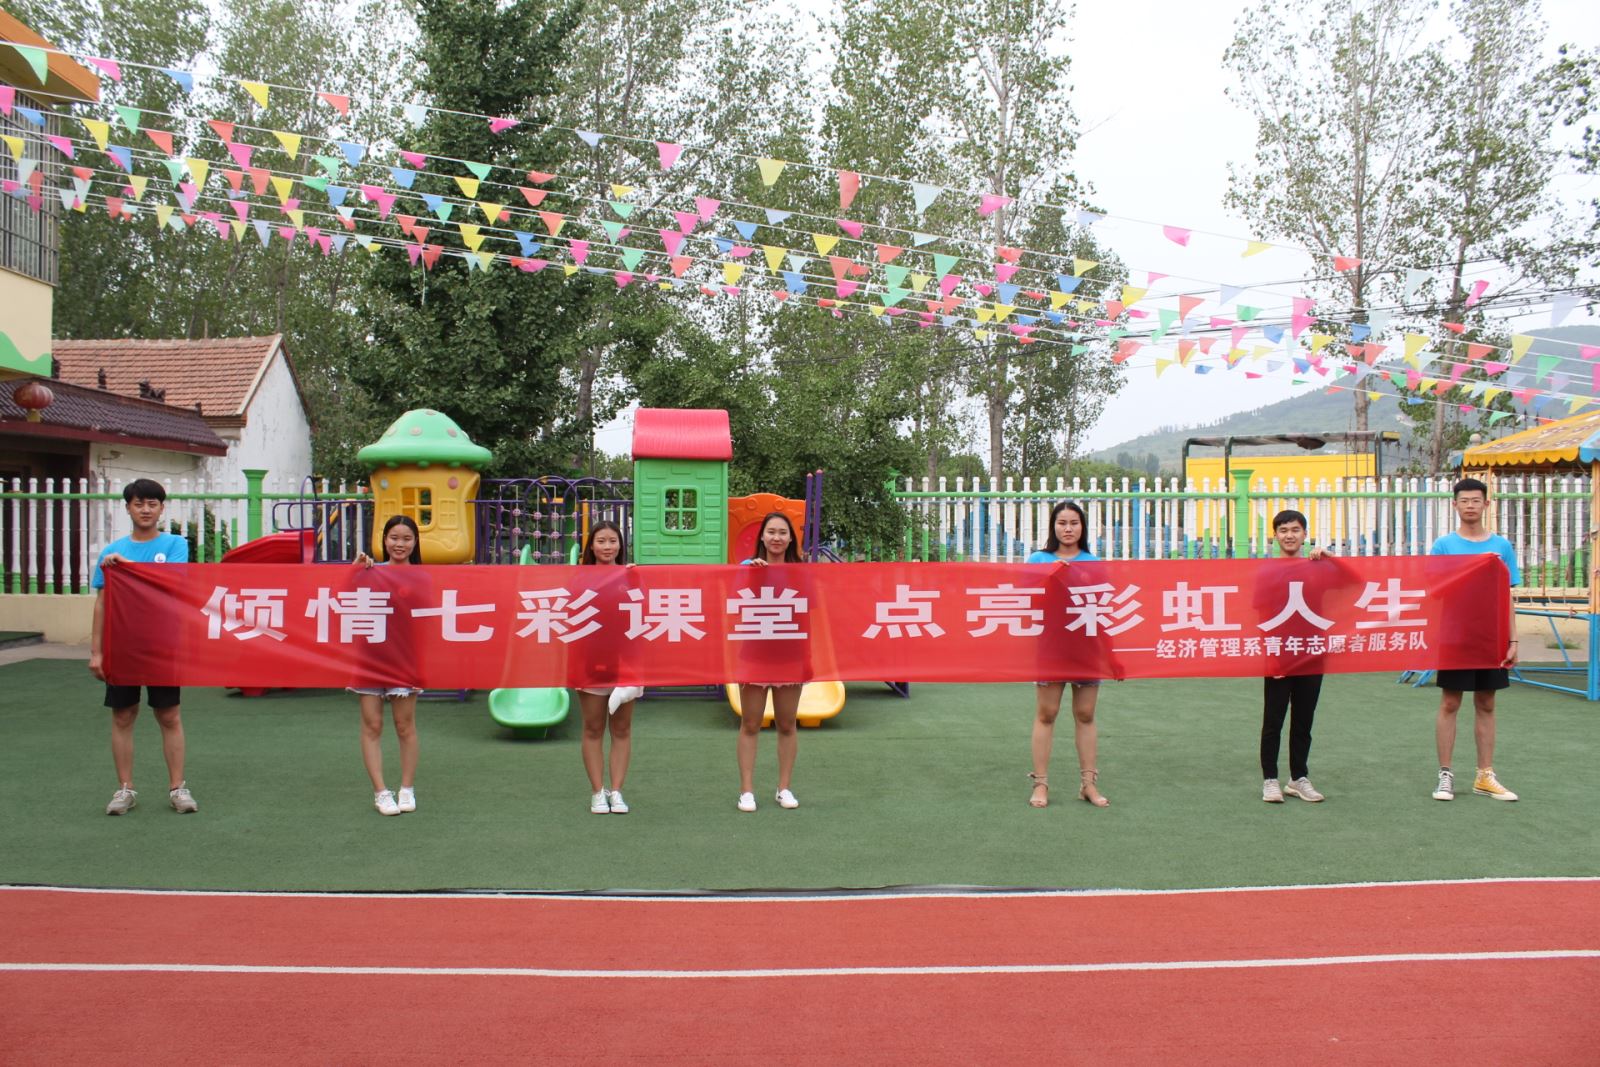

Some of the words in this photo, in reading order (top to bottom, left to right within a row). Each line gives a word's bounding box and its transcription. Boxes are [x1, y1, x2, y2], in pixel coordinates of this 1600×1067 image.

[199, 585, 808, 644] 倾情七彩课堂
[862, 578, 1428, 639] 点亮彩虹人生
